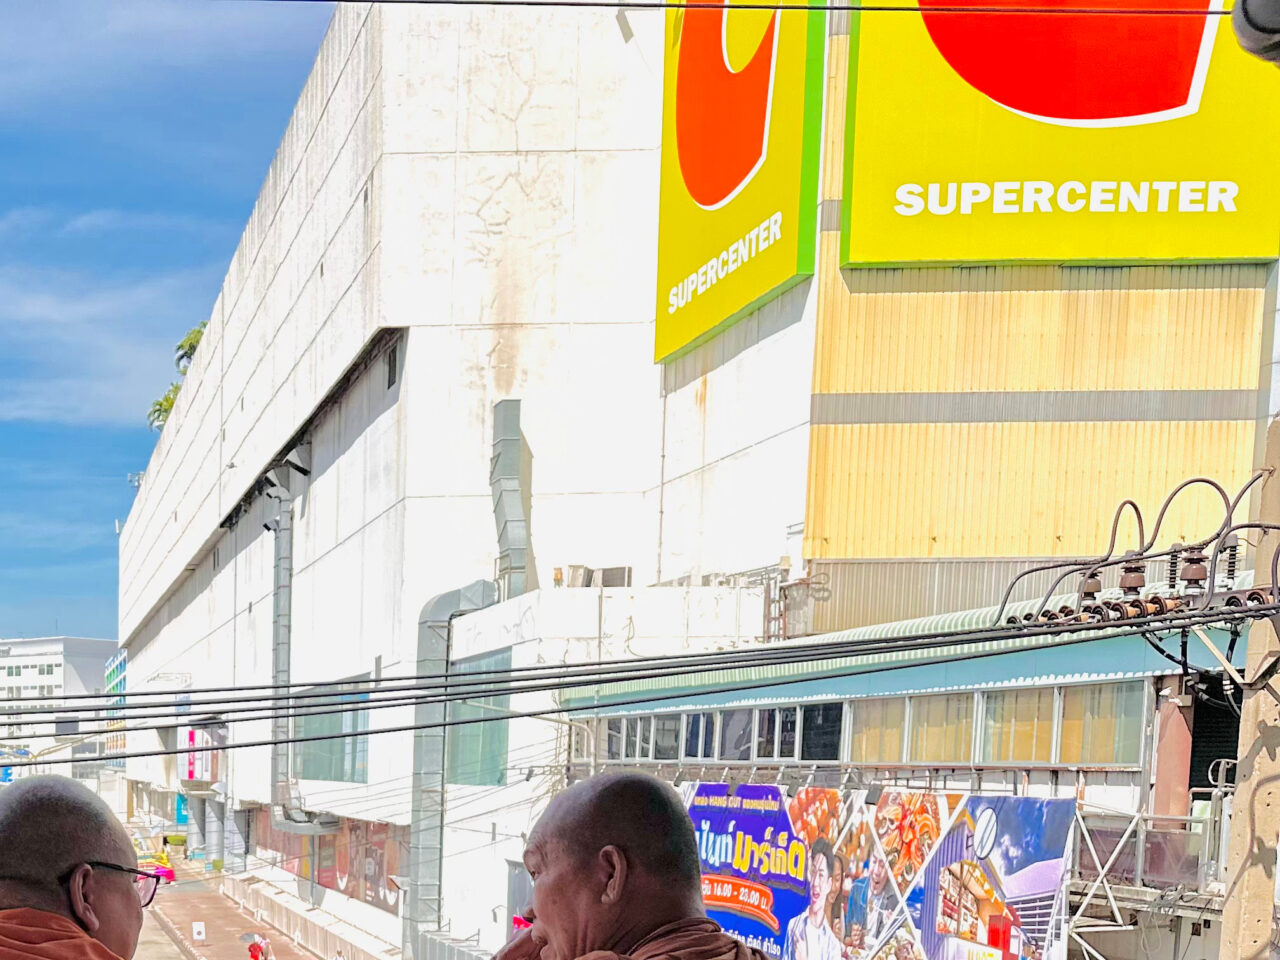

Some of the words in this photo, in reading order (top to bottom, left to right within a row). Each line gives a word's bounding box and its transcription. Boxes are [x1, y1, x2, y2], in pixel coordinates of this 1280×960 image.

[894, 180, 1239, 216] SUPERCENTER
[668, 211, 783, 314] SUPERCENTER
[714, 883, 732, 898] 16.00
[739, 887, 760, 906] 23.00
